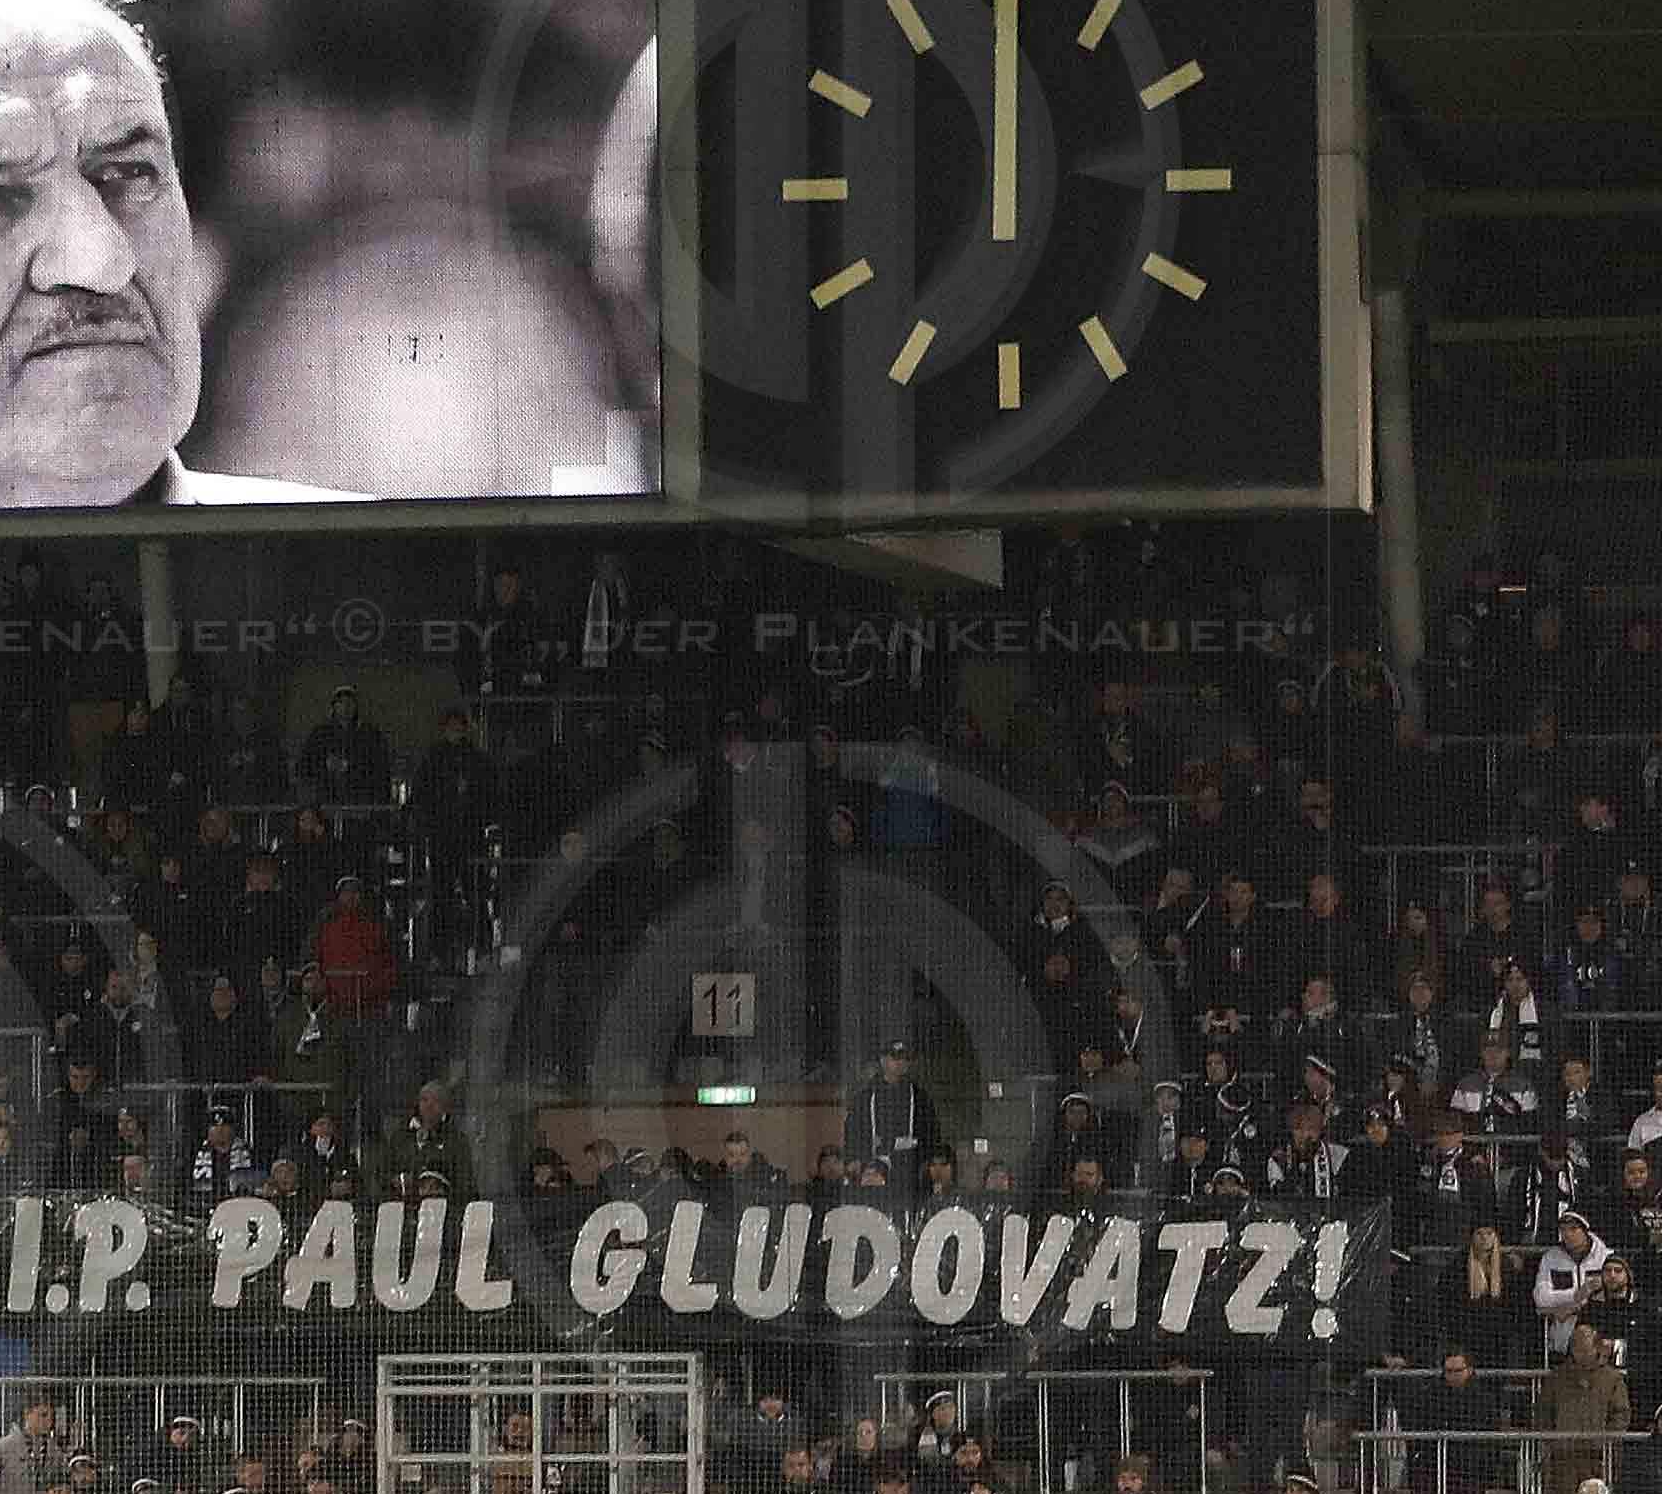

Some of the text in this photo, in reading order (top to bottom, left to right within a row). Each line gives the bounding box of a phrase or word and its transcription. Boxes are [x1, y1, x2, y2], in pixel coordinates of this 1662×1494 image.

[702, 980, 743, 1028] 11
[207, 1196, 515, 1317] PAUL
[569, 1198, 1350, 1340] GLUDOVATZ!
